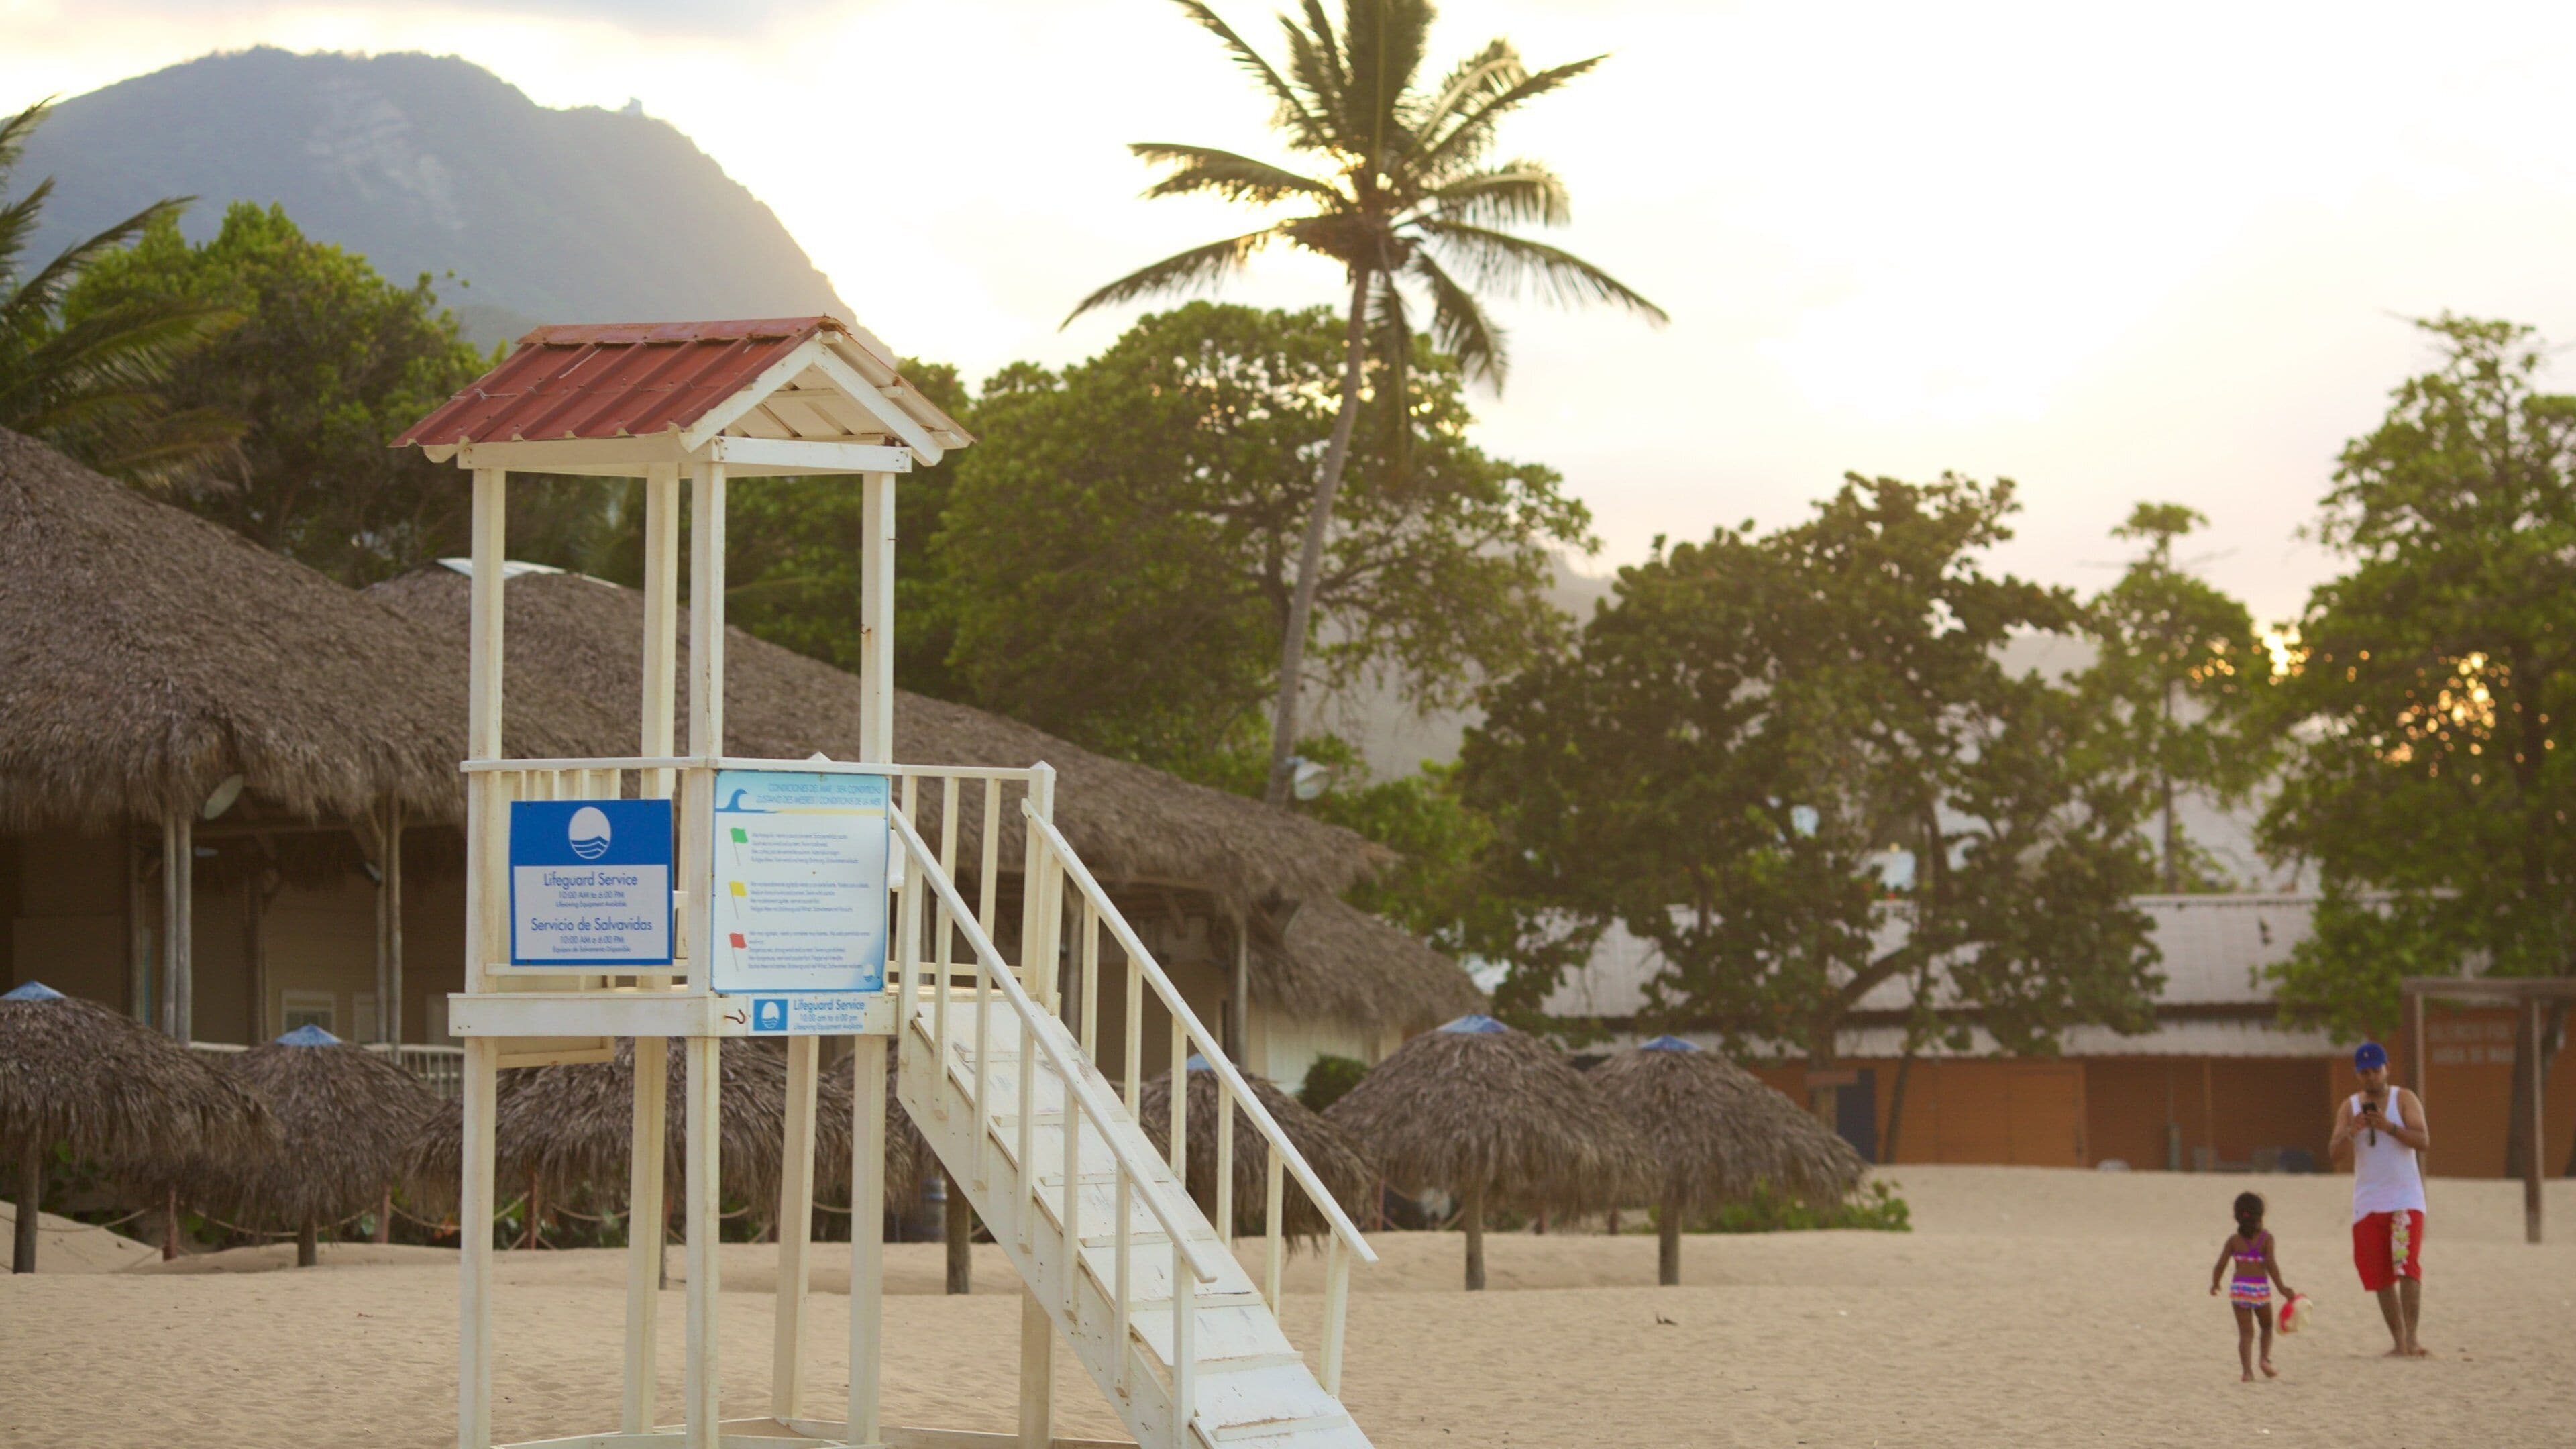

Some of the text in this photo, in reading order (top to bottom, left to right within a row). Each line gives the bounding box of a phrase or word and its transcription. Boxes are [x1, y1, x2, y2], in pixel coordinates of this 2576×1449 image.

[543, 871, 638, 890] Lifeguard Service
[559, 890, 576, 899] 10:00
[578, 890, 590, 899] AM
[590, 891, 597, 899] to
[614, 890, 625, 899] PM
[531, 916, 653, 931] Servicio de Salvavidas
[560, 936, 578, 944] 10:00
[579, 936, 590, 944] AM
[614, 936, 625, 944] PM
[793, 998, 865, 1013] Lifeguard Service
[800, 1014, 816, 1022] 10:00
[827, 1014, 833, 1022] to
[849, 1015, 858, 1023] pm
